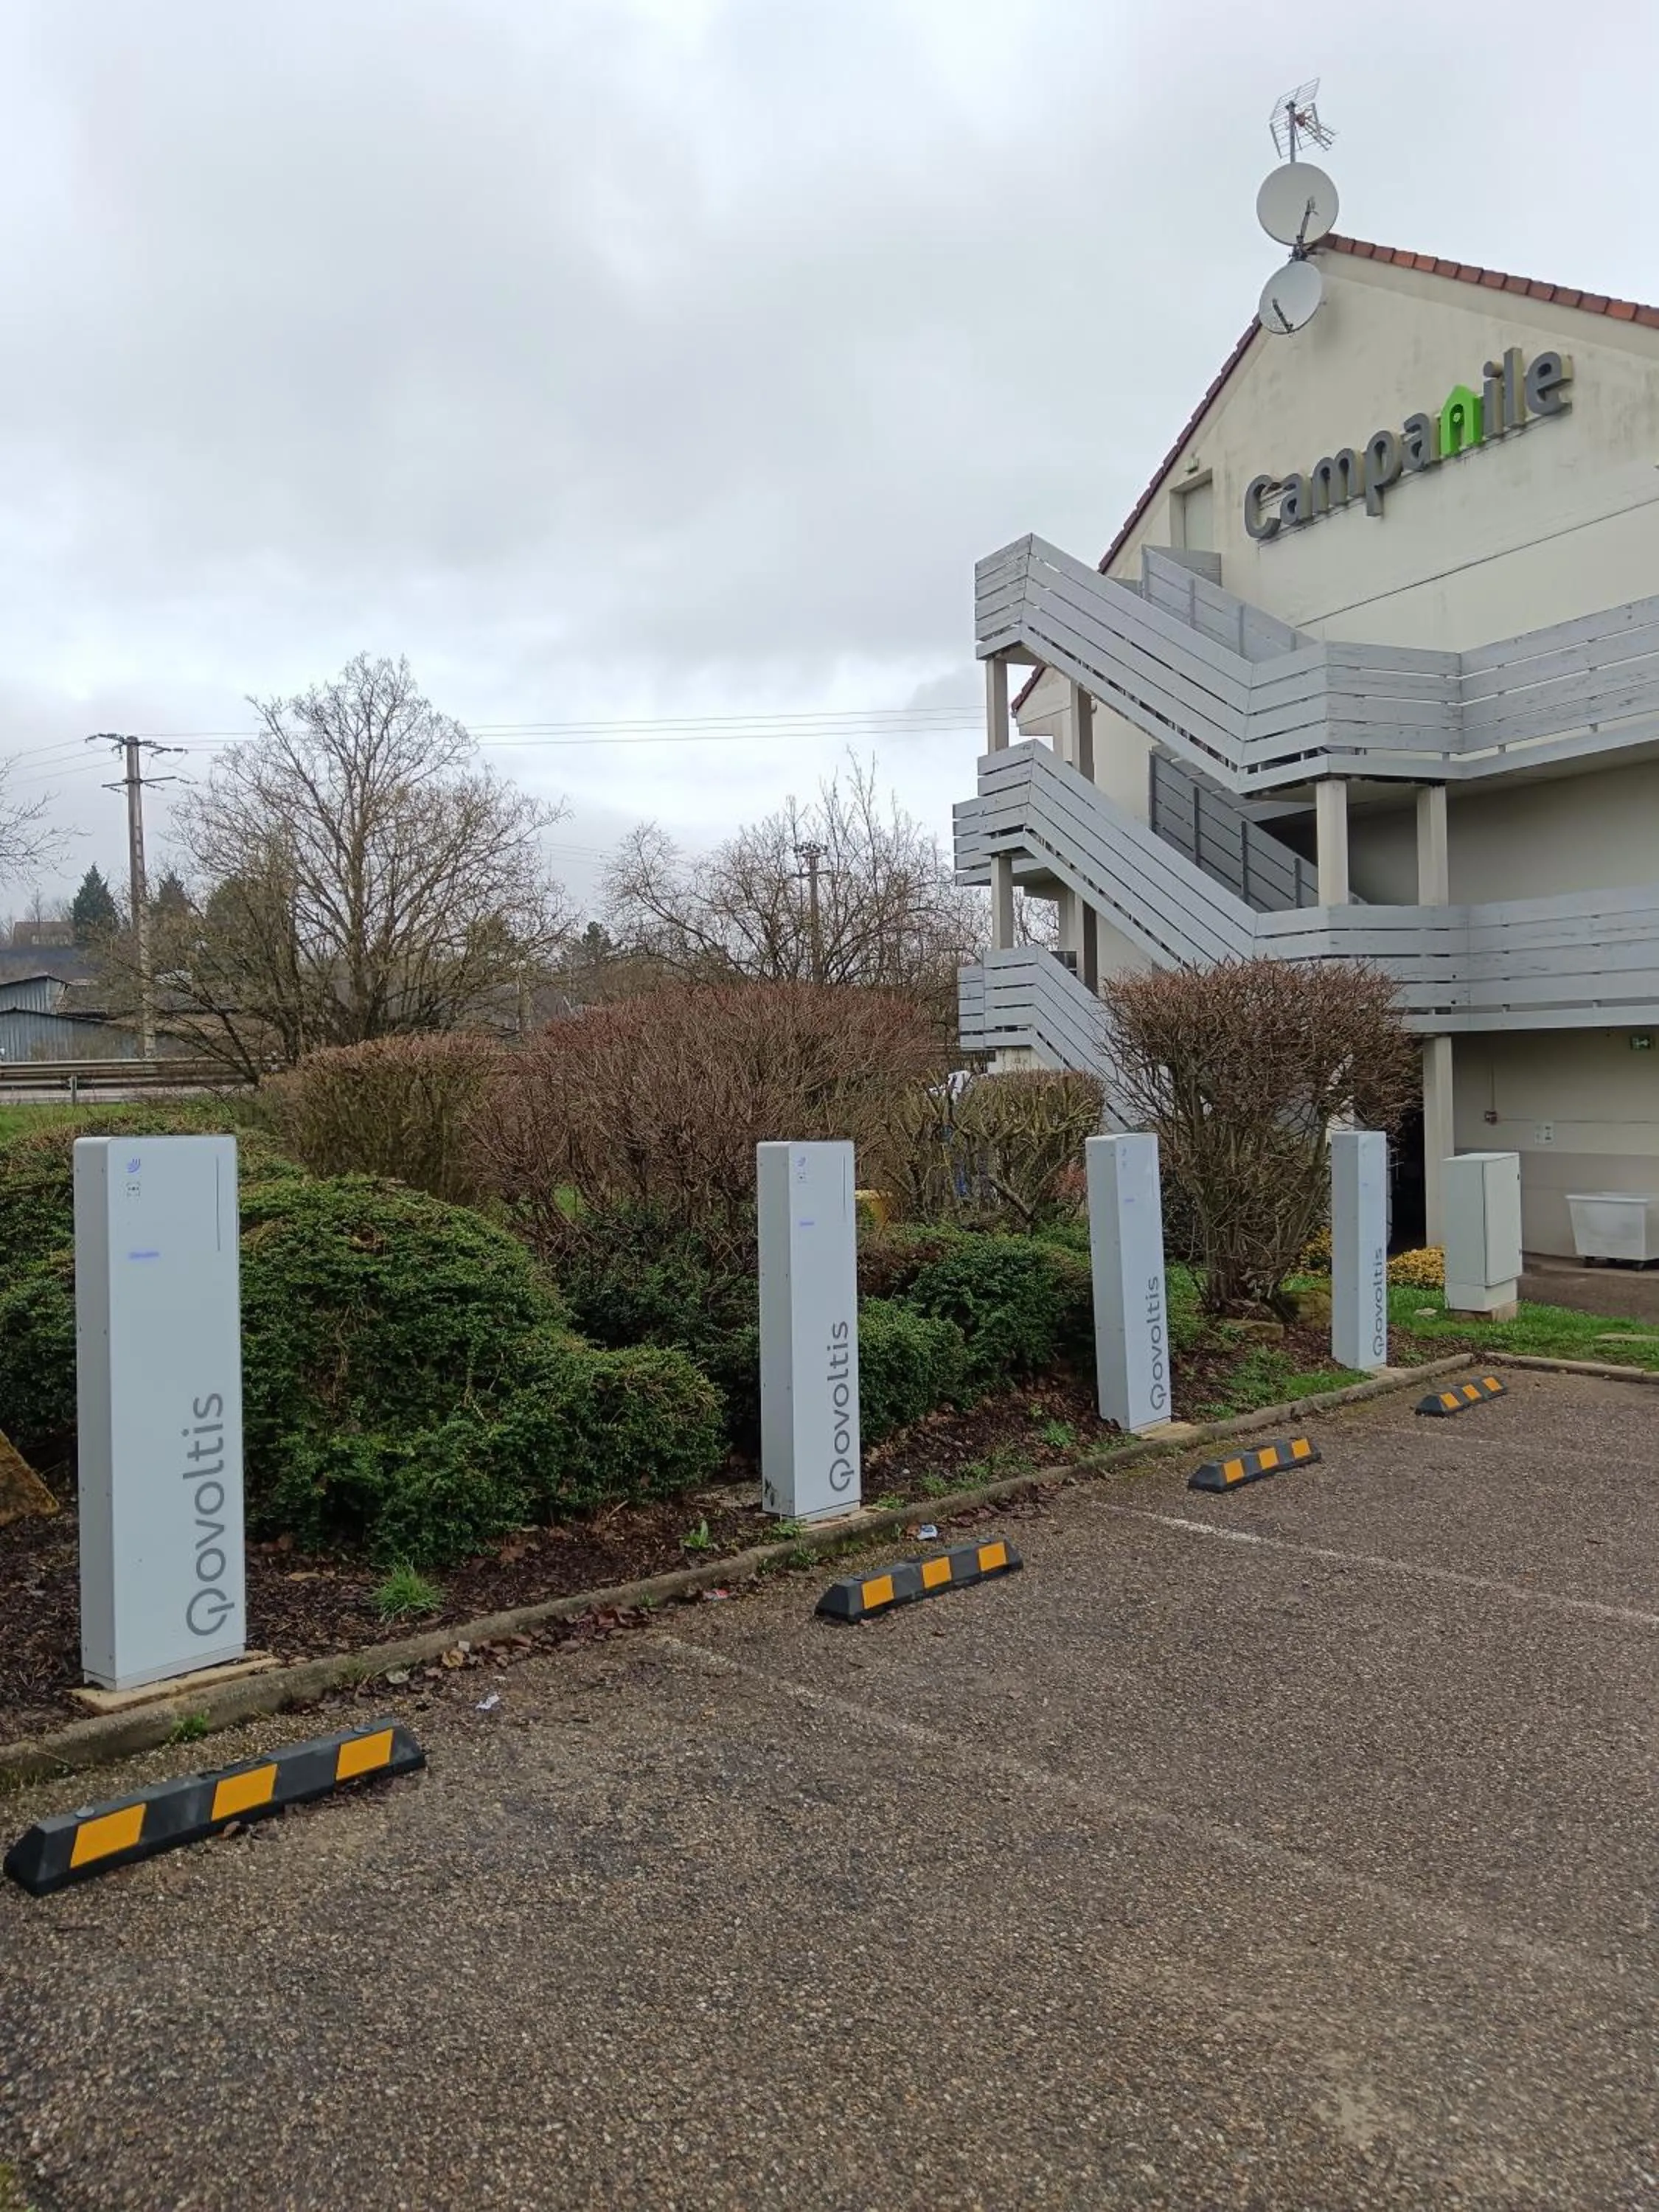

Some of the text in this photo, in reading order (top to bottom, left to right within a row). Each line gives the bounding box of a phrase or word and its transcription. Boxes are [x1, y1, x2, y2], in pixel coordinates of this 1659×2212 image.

[1245, 347, 1573, 538] campanile
[1146, 1276, 1166, 1409] Qovoltis
[1373, 1249, 1385, 1356] Qovoltis
[827, 1322, 854, 1491] Qovoltis
[183, 1393, 235, 1635] Qovoltis
